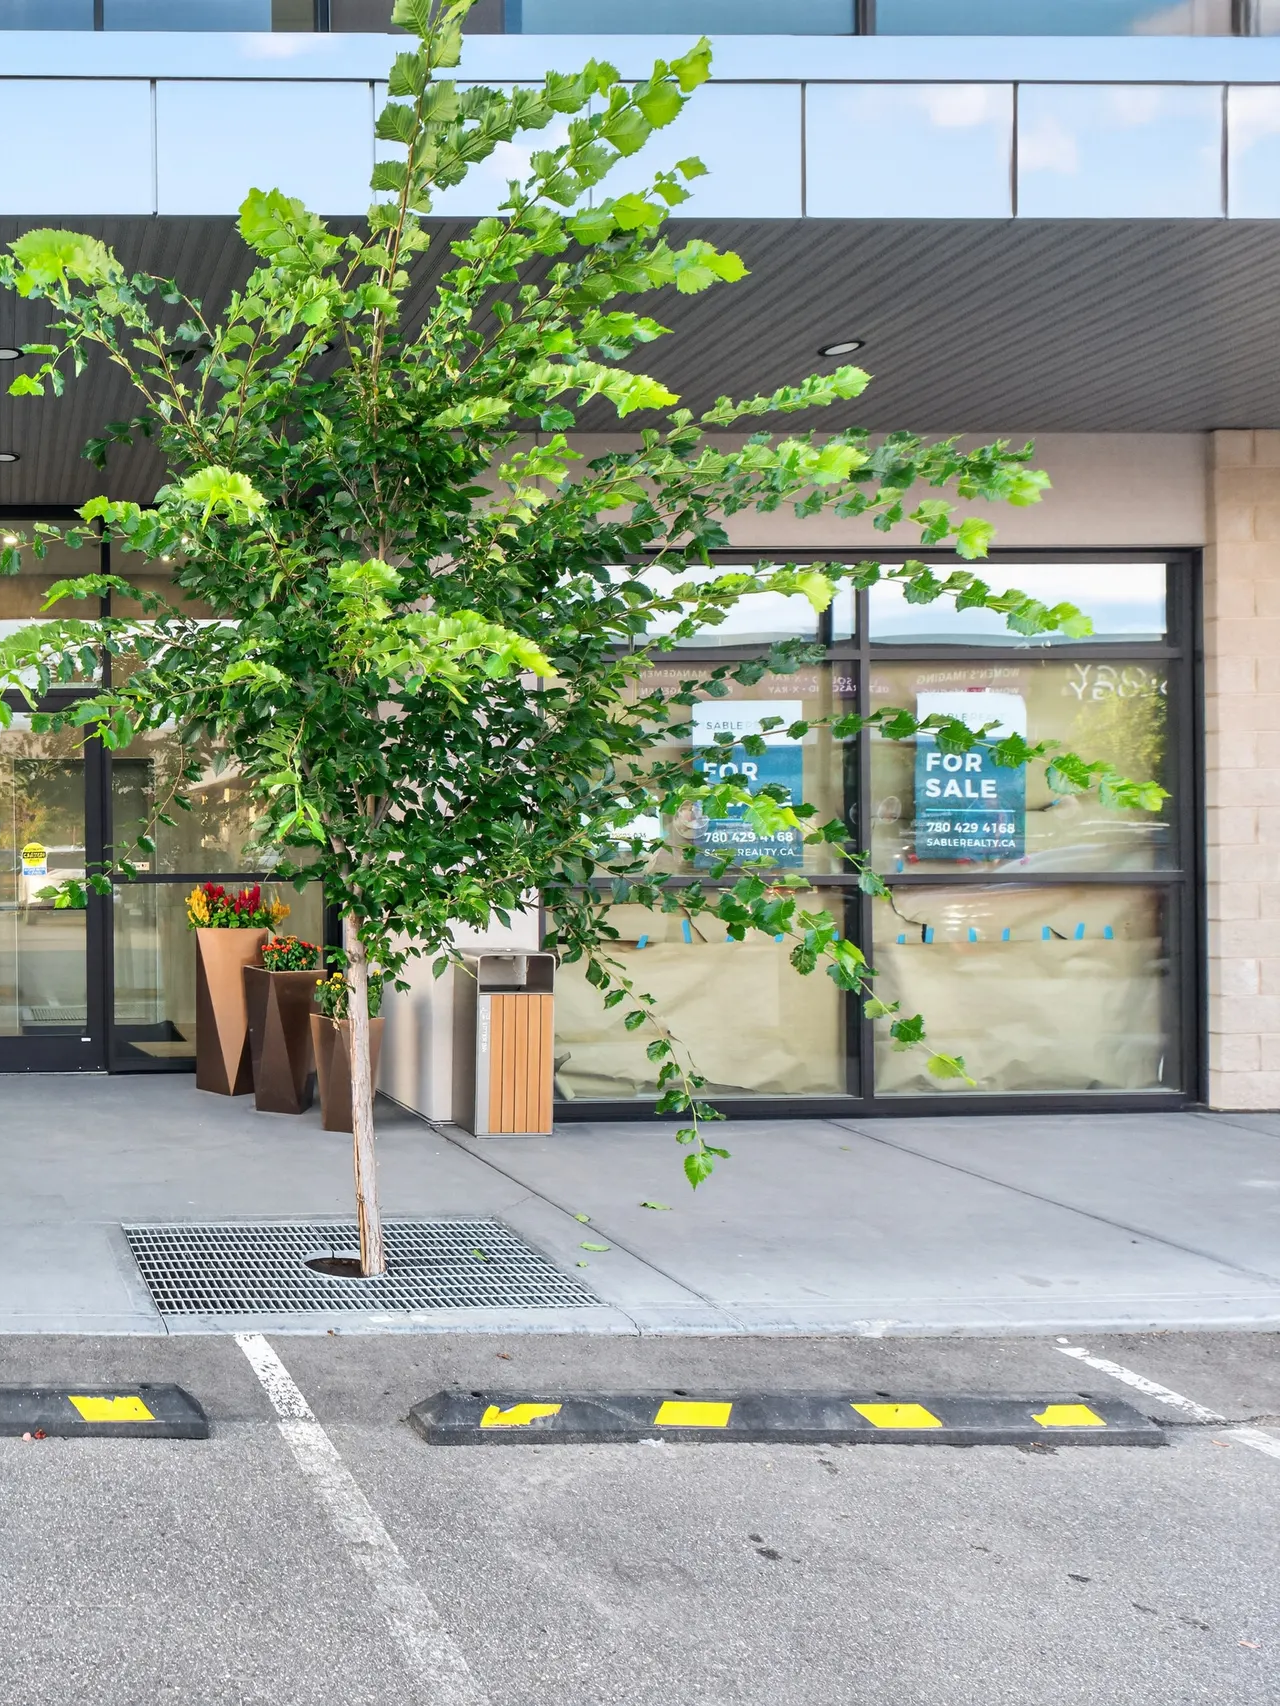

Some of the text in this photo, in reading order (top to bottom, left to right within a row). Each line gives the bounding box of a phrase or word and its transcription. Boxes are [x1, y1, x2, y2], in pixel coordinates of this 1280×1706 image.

[925, 752, 983, 773] FOR
[925, 778, 998, 799] SALE
[926, 822, 1016, 834] 780 429 4168
[703, 832, 728, 843] 780
[731, 832, 756, 843] 429
[926, 838, 1016, 848] SABLEREALTY.CA
